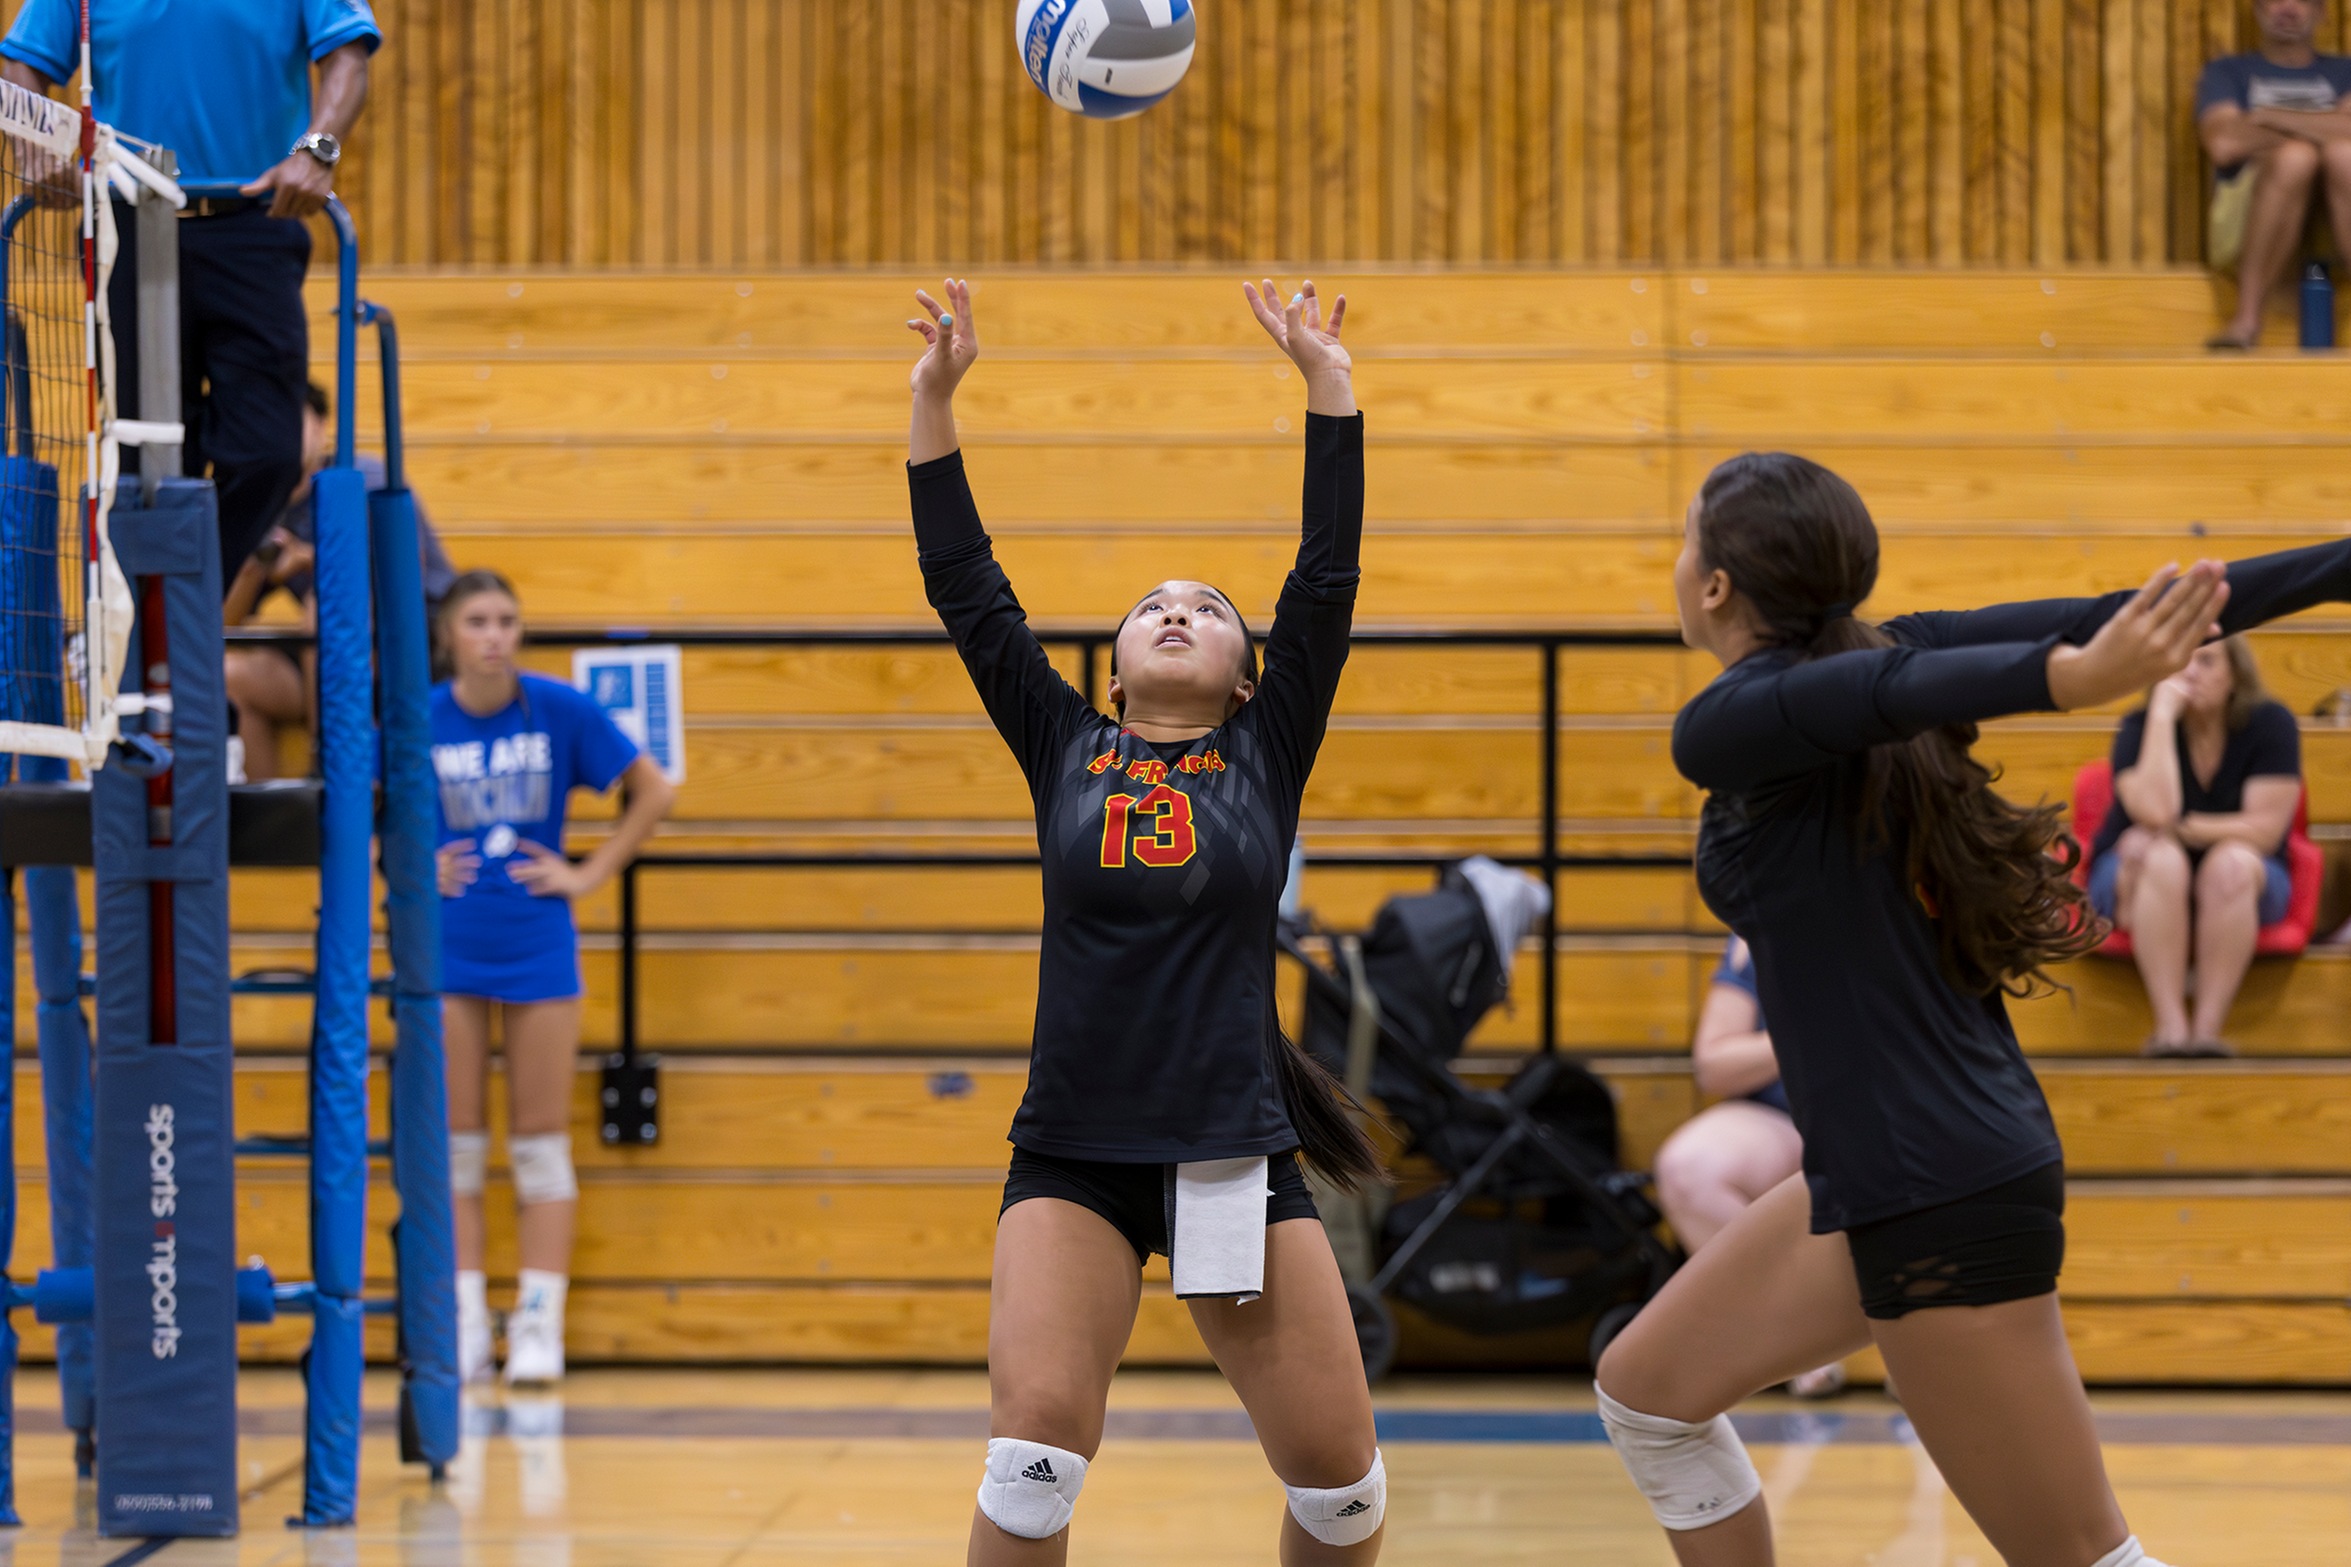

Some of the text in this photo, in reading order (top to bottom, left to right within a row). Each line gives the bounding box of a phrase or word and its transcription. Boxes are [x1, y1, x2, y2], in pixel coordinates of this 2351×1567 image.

[430, 732, 553, 782] WE ARE
[1100, 783, 1197, 868] 13
[144, 1103, 179, 1218] sports
[1021, 1465, 1057, 1484] adidas
